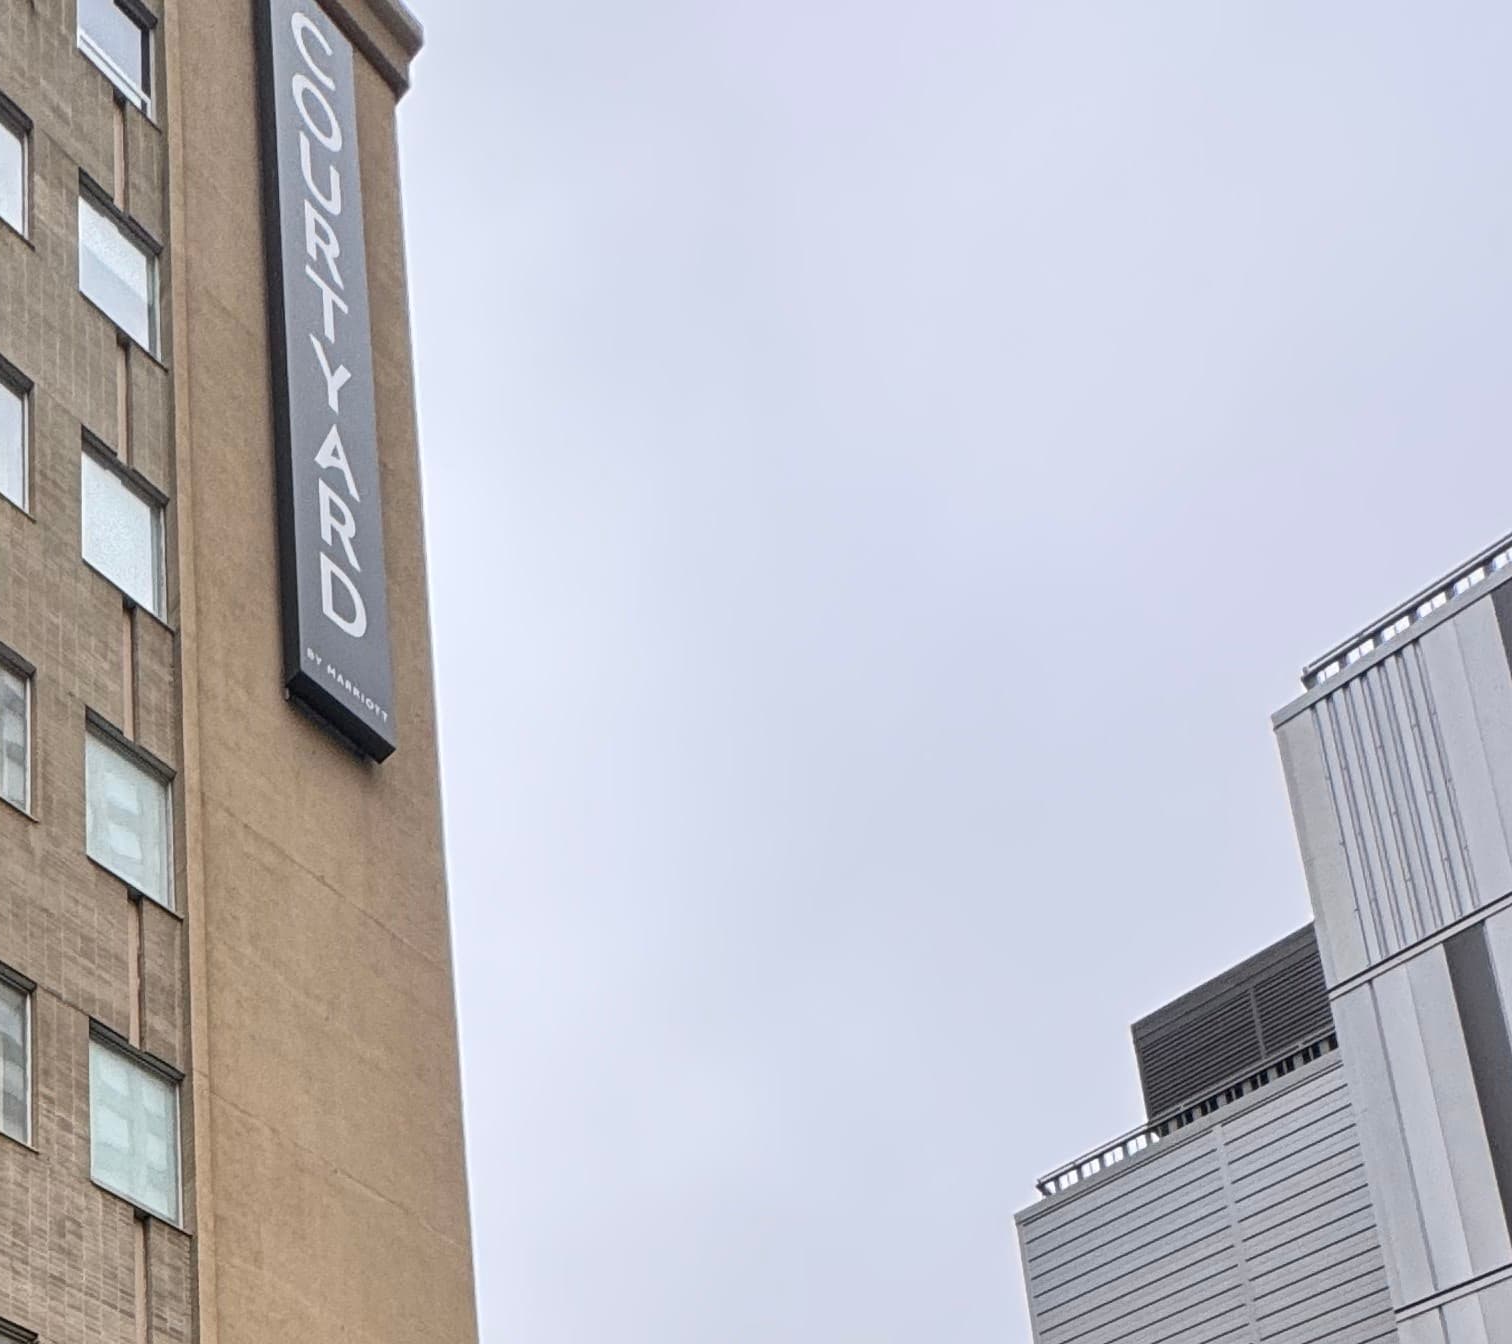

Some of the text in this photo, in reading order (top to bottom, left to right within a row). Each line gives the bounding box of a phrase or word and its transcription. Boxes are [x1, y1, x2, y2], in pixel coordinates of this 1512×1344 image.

[291, 12, 367, 638] COURTYARD
[306, 647, 388, 722] BY MARRIOTT
